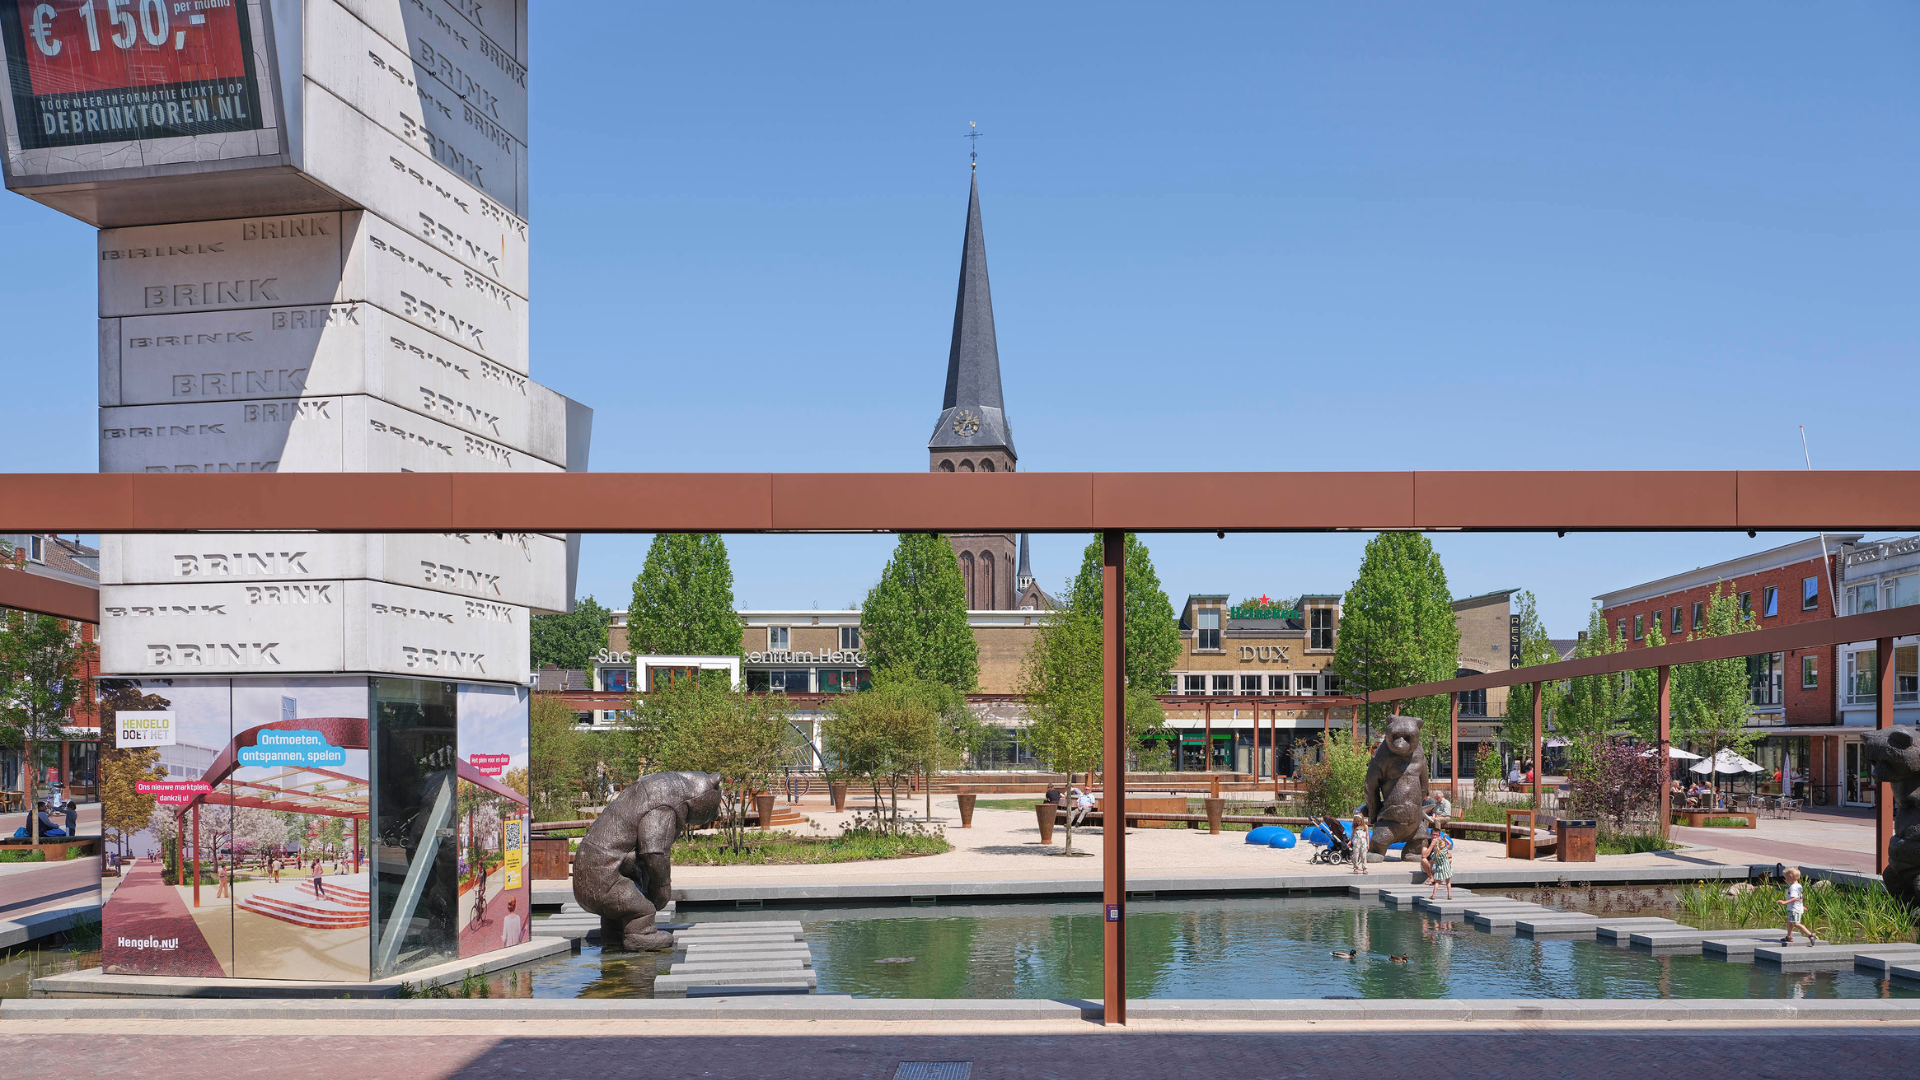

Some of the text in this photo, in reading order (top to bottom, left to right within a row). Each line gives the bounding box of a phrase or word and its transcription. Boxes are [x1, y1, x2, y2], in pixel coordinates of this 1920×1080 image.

[174, 1, 191, 15] per
[29, 3, 62, 56] €
[480, 35, 526, 90] BRINK
[368, 50, 453, 120] BRINK
[418, 37, 499, 120] BRINK
[41, 83, 243, 111] VOOR MEER INFORMATIE KIJKT U OP
[43, 95, 247, 135] DEBRINKTOREN.NL
[463, 103, 511, 155] BRINK
[400, 111, 484, 188] BRINK
[389, 155, 470, 215] BRINK
[243, 216, 330, 241] BRINK
[480, 197, 526, 242] BRINK
[102, 242, 225, 260] BRINK
[419, 211, 499, 277] BRINK
[370, 235, 453, 288] BRINK
[145, 277, 280, 308] BRINK
[464, 269, 511, 311] BRINK
[272, 306, 360, 330] BRINK
[401, 290, 485, 351] BRINK
[130, 331, 253, 348] BRINK
[390, 336, 470, 380] BRINK
[172, 368, 308, 397] BRINK
[244, 401, 330, 423] BRINK
[420, 386, 500, 437] BRINK
[104, 423, 226, 439] BRINK
[370, 419, 453, 456] BRINK
[464, 435, 512, 468] BRINK
[174, 551, 309, 577] BRINK
[420, 560, 501, 596] BRINK
[245, 584, 332, 604] BRINK
[105, 604, 226, 617] BRINK
[372, 603, 454, 624] BRINK
[465, 600, 512, 624] BRINK
[1230, 606, 1299, 620] Heineken
[147, 642, 281, 666] BRINK
[1240, 645, 1290, 662] DUX
[1511, 617, 1519, 669] RESTAU
[402, 646, 486, 674] BRINK
[819, 647, 868, 668] Heng
[122, 719, 170, 729] HENGELO
[122, 729, 169, 740] DOET HET
[262, 734, 322, 746] Ontmoeten,
[242, 750, 341, 763] ontspannen, spelen
[160, 794, 181, 802] dankzij
[174, 783, 211, 792] marktplein,
[117, 935, 179, 950] Hengelo.NU!
